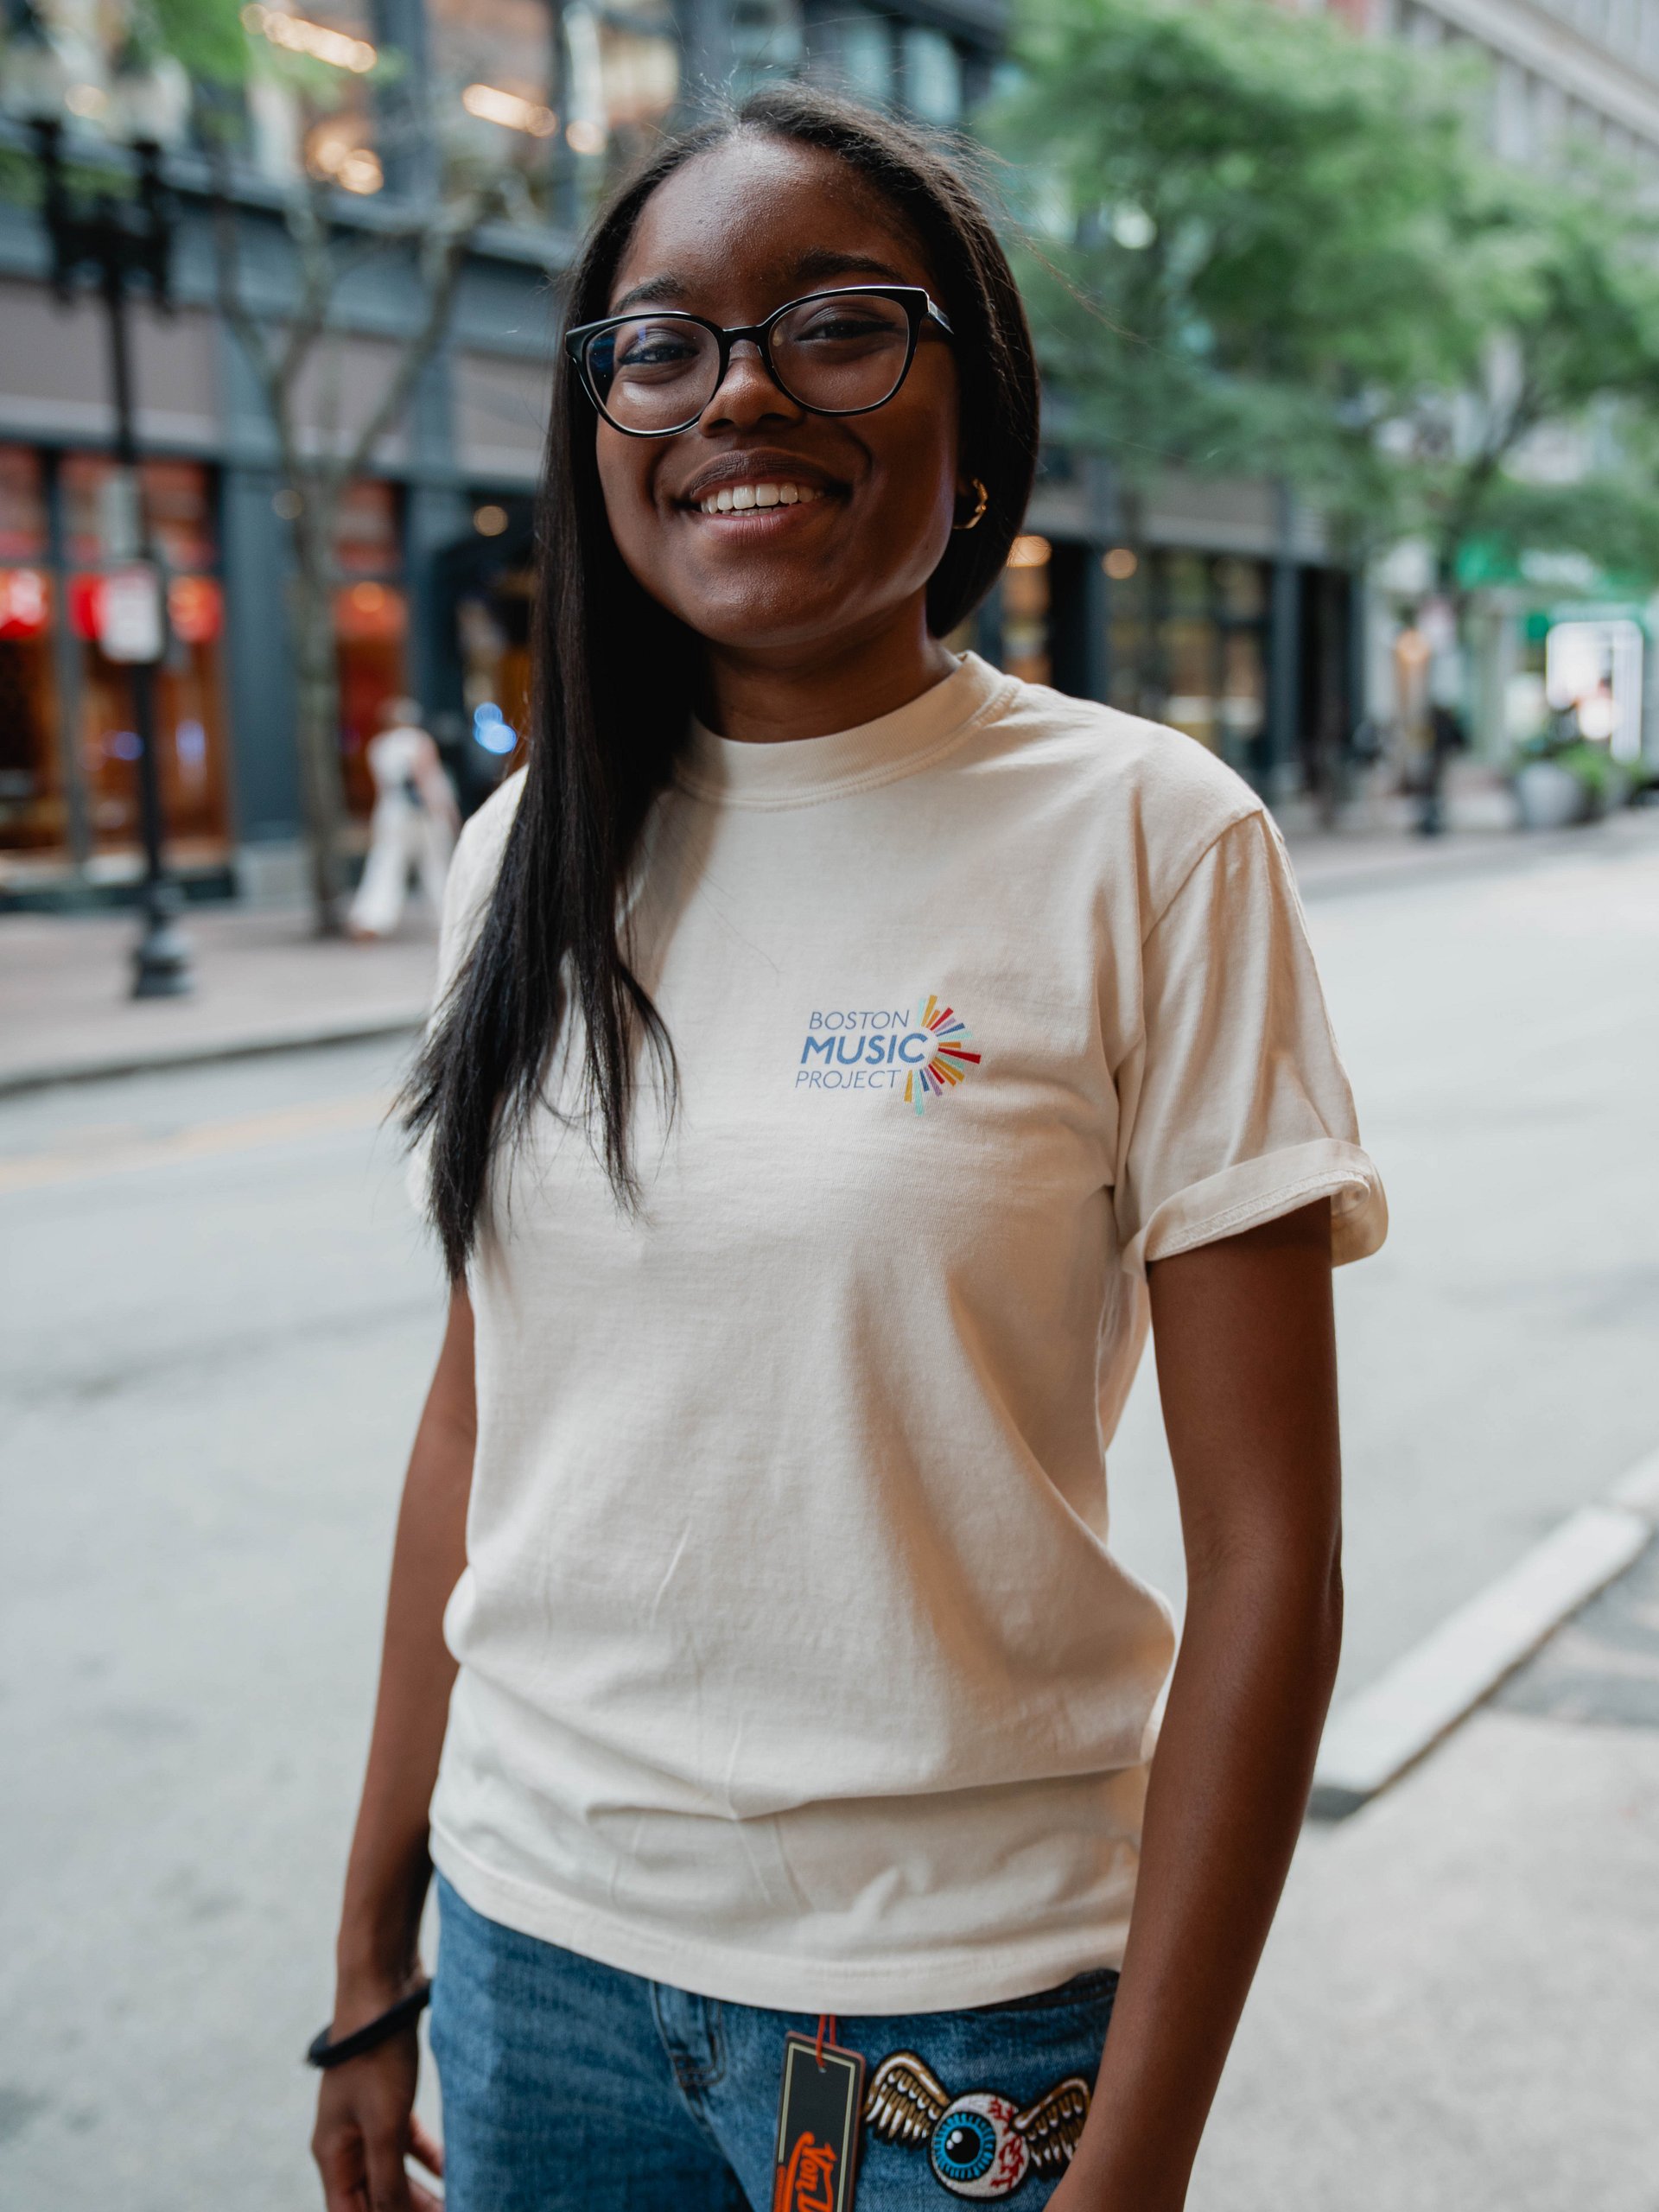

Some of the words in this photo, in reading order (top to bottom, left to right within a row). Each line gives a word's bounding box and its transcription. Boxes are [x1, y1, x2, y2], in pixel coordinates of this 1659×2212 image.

[810, 1009, 910, 1030] BOSTON
[800, 1033, 928, 1065] MUSIC
[795, 1070, 901, 1089] PROJECT
[796, 2142, 837, 2192] Von
